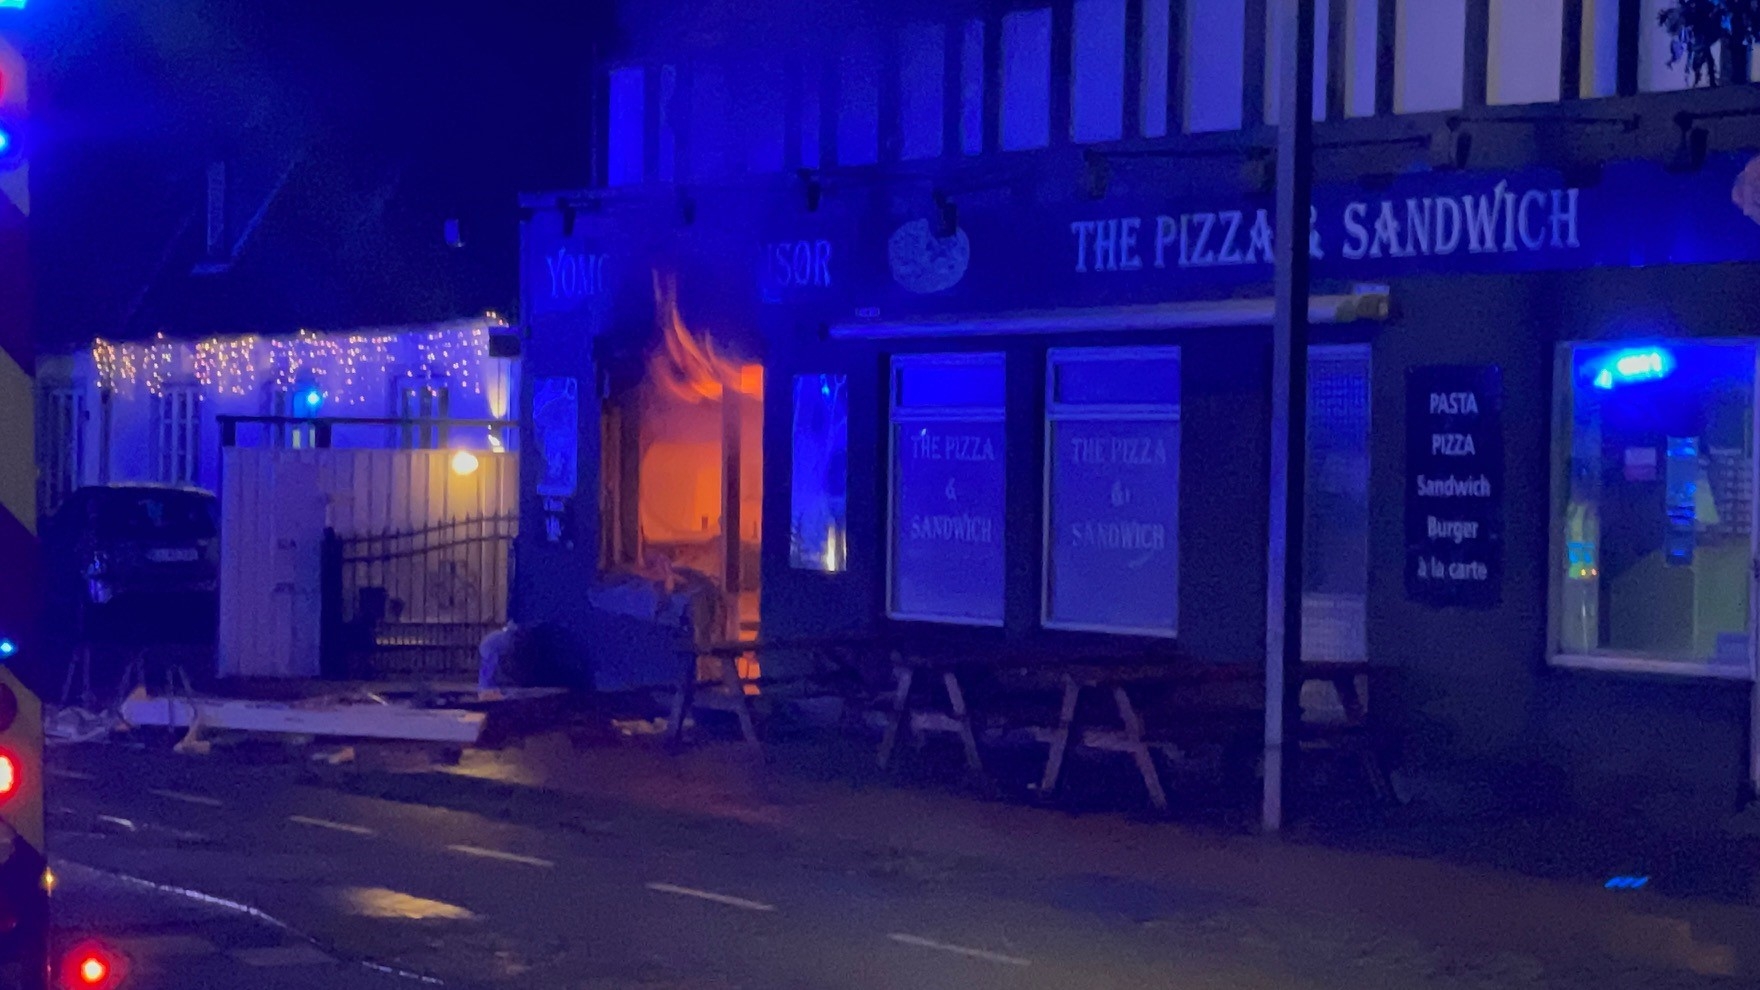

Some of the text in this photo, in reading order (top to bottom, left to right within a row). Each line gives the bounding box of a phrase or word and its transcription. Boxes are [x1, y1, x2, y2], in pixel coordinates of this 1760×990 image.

[1071, 217, 1143, 272] THE
[1154, 209, 1274, 268] PIZZA
[1342, 179, 1580, 260] SANDWICH
[1429, 391, 1479, 415] PASTA
[910, 432, 995, 462] THE PIZZA
[1070, 436, 1167, 466] THE PIZZA
[1432, 433, 1476, 456] PIZZA
[1417, 473, 1491, 497] Sandwich
[909, 512, 992, 543] SANDWICH
[1070, 519, 1165, 550] SANDWICH
[1427, 514, 1479, 544] Burger
[1431, 555, 1445, 578] la
[1449, 560, 1488, 580] carte
